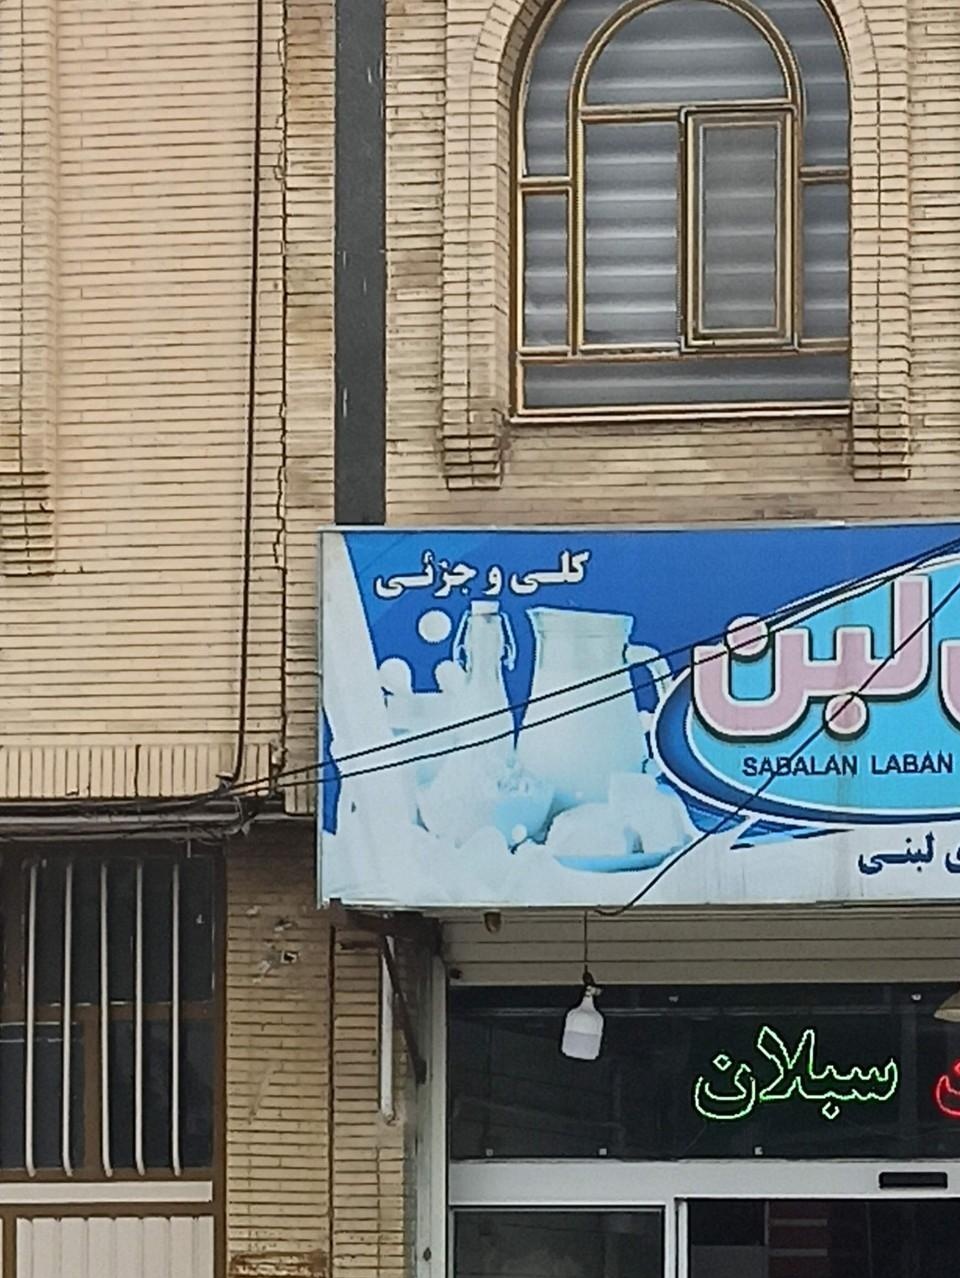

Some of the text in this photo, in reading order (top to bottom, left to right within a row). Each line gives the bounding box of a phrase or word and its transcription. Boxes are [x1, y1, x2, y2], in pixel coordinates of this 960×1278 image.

[482, 563, 502, 596] و
[510, 549, 591, 595] کلی
[691, 574, 931, 742] لبن
[742, 751, 953, 777] SABALAN LABAN
[858, 831, 935, 875] لبنی
[694, 1025, 898, 1120] سبلان
